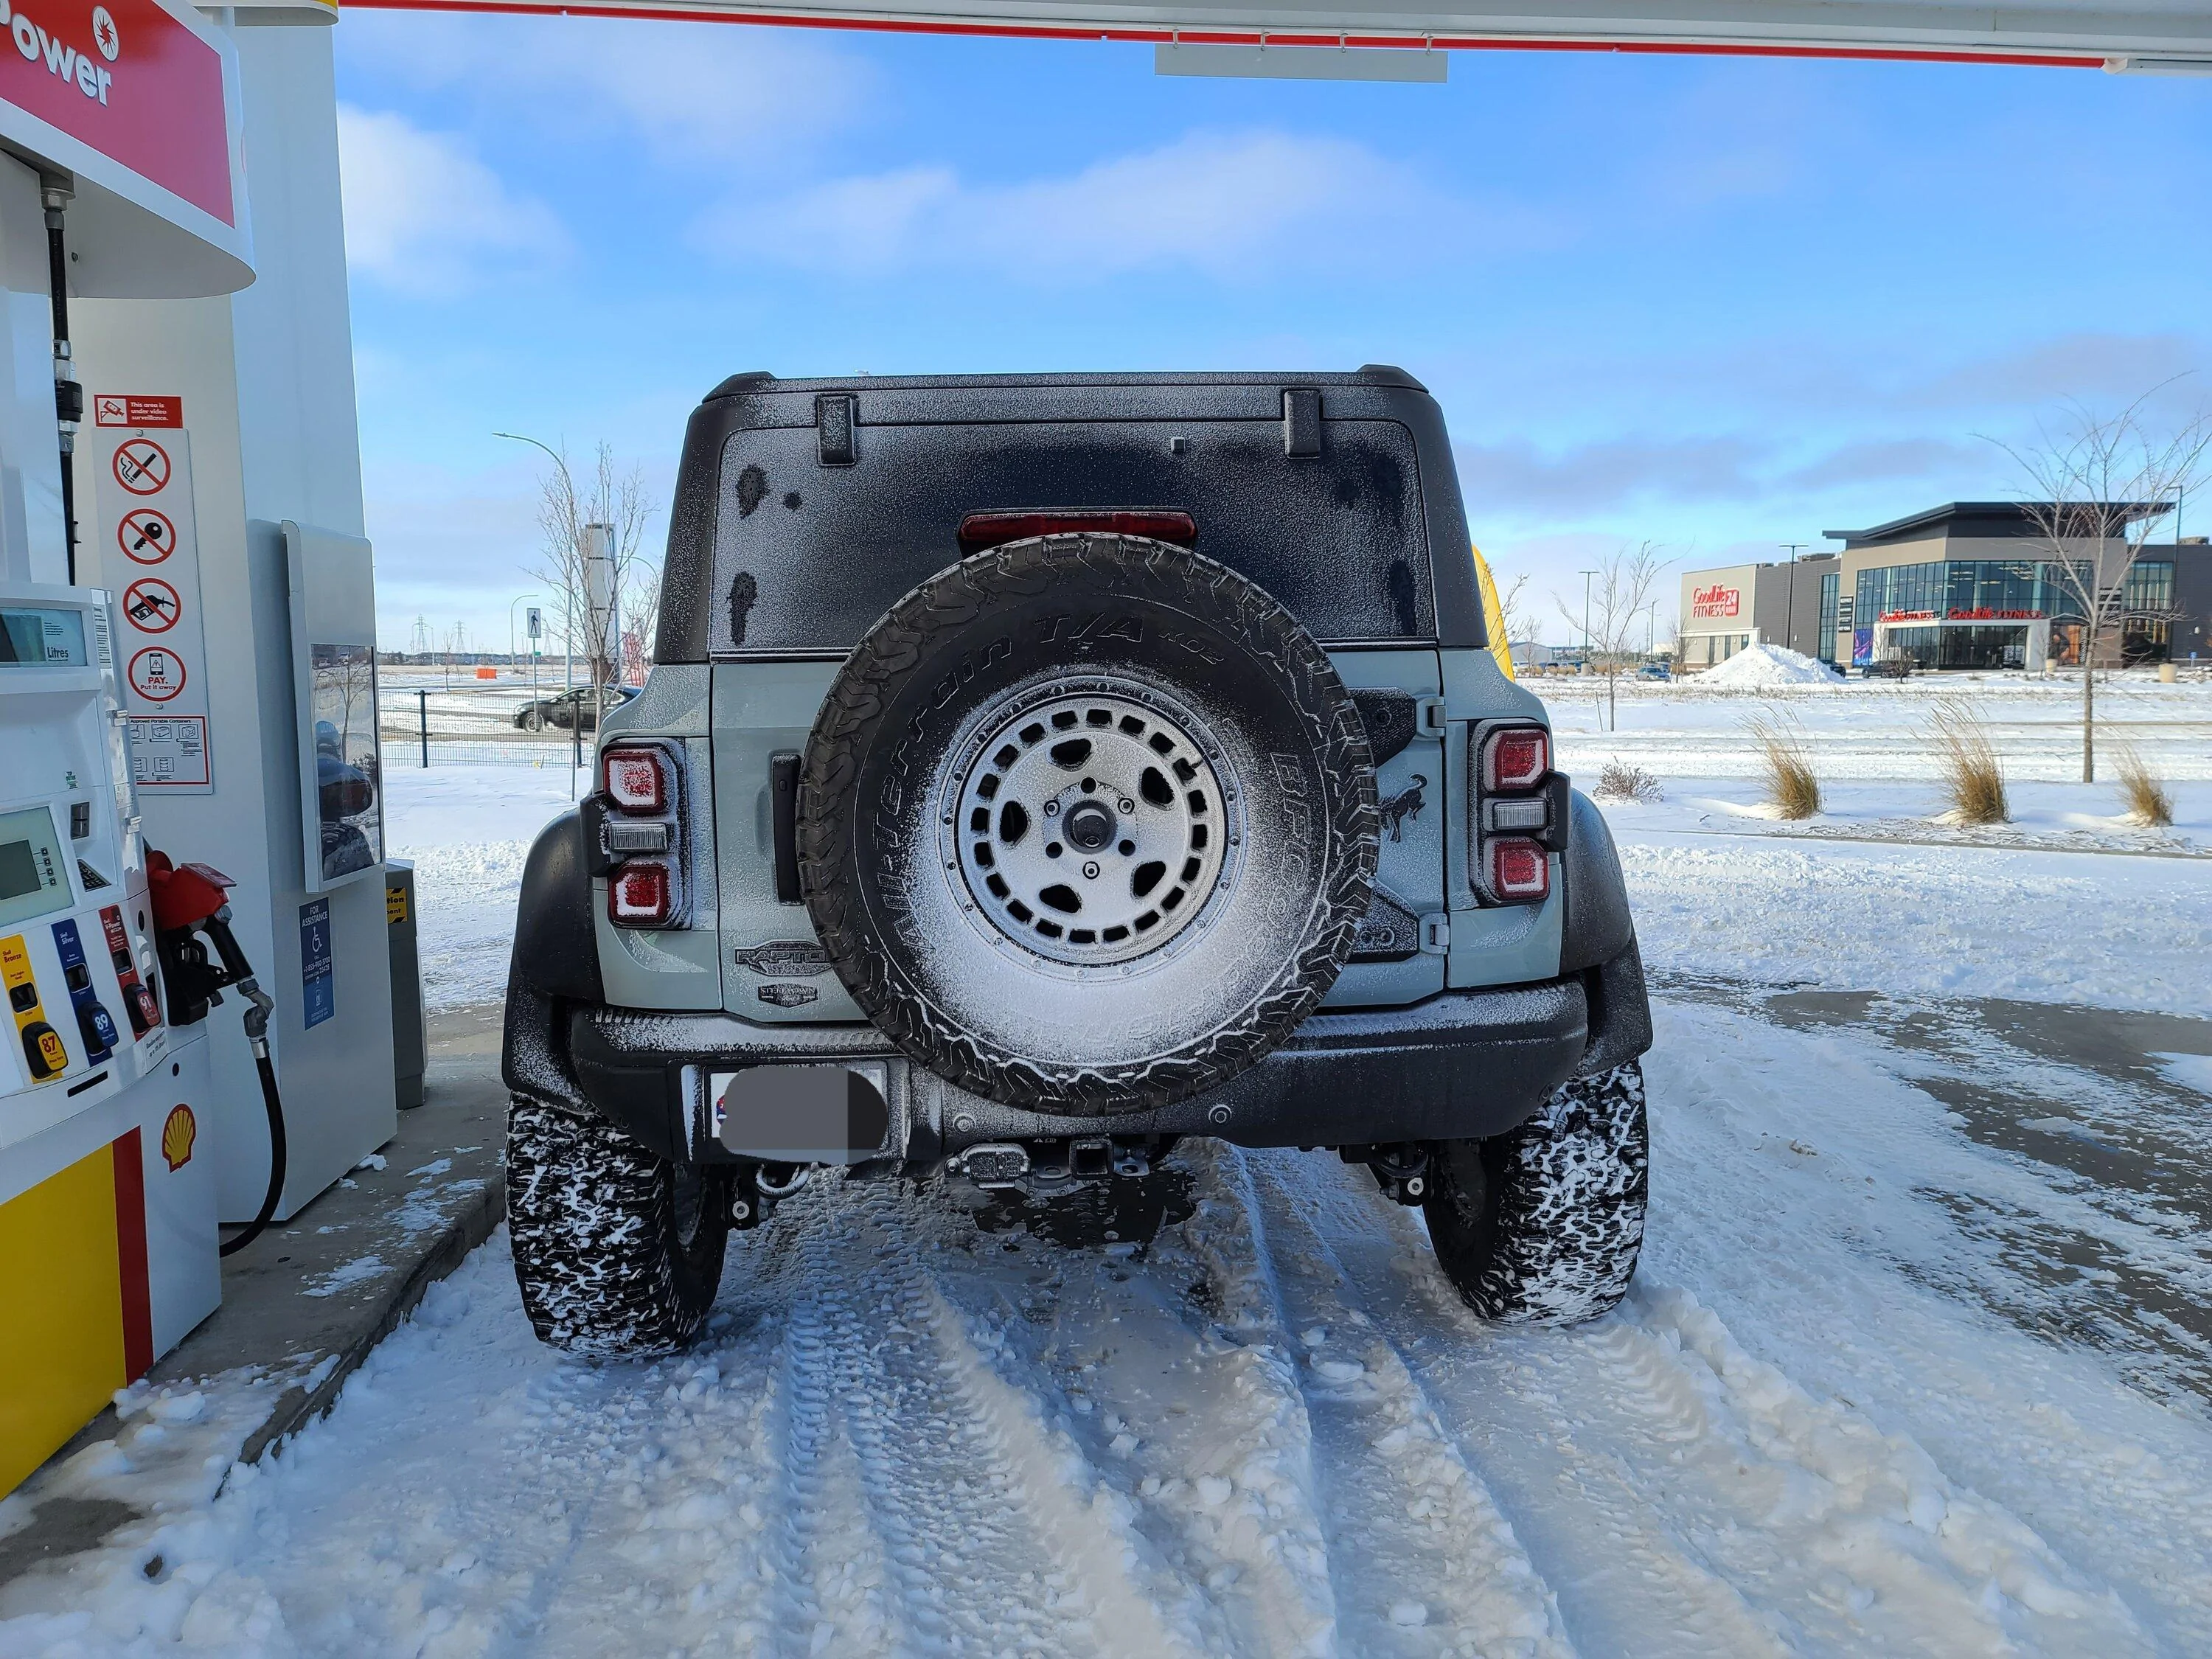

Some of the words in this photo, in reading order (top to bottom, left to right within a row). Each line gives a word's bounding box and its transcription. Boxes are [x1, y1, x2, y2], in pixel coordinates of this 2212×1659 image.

[1693, 585, 1725, 604] GoodLife
[1693, 605, 1724, 618] FITNESS
[46, 647, 69, 658] Litres
[310, 905, 319, 916] FOR
[302, 911, 328, 928] ASSISTANCE
[4, 953, 22, 963] Bronze
[94, 1014, 108, 1031] 89
[41, 1034, 56, 1053] 87
